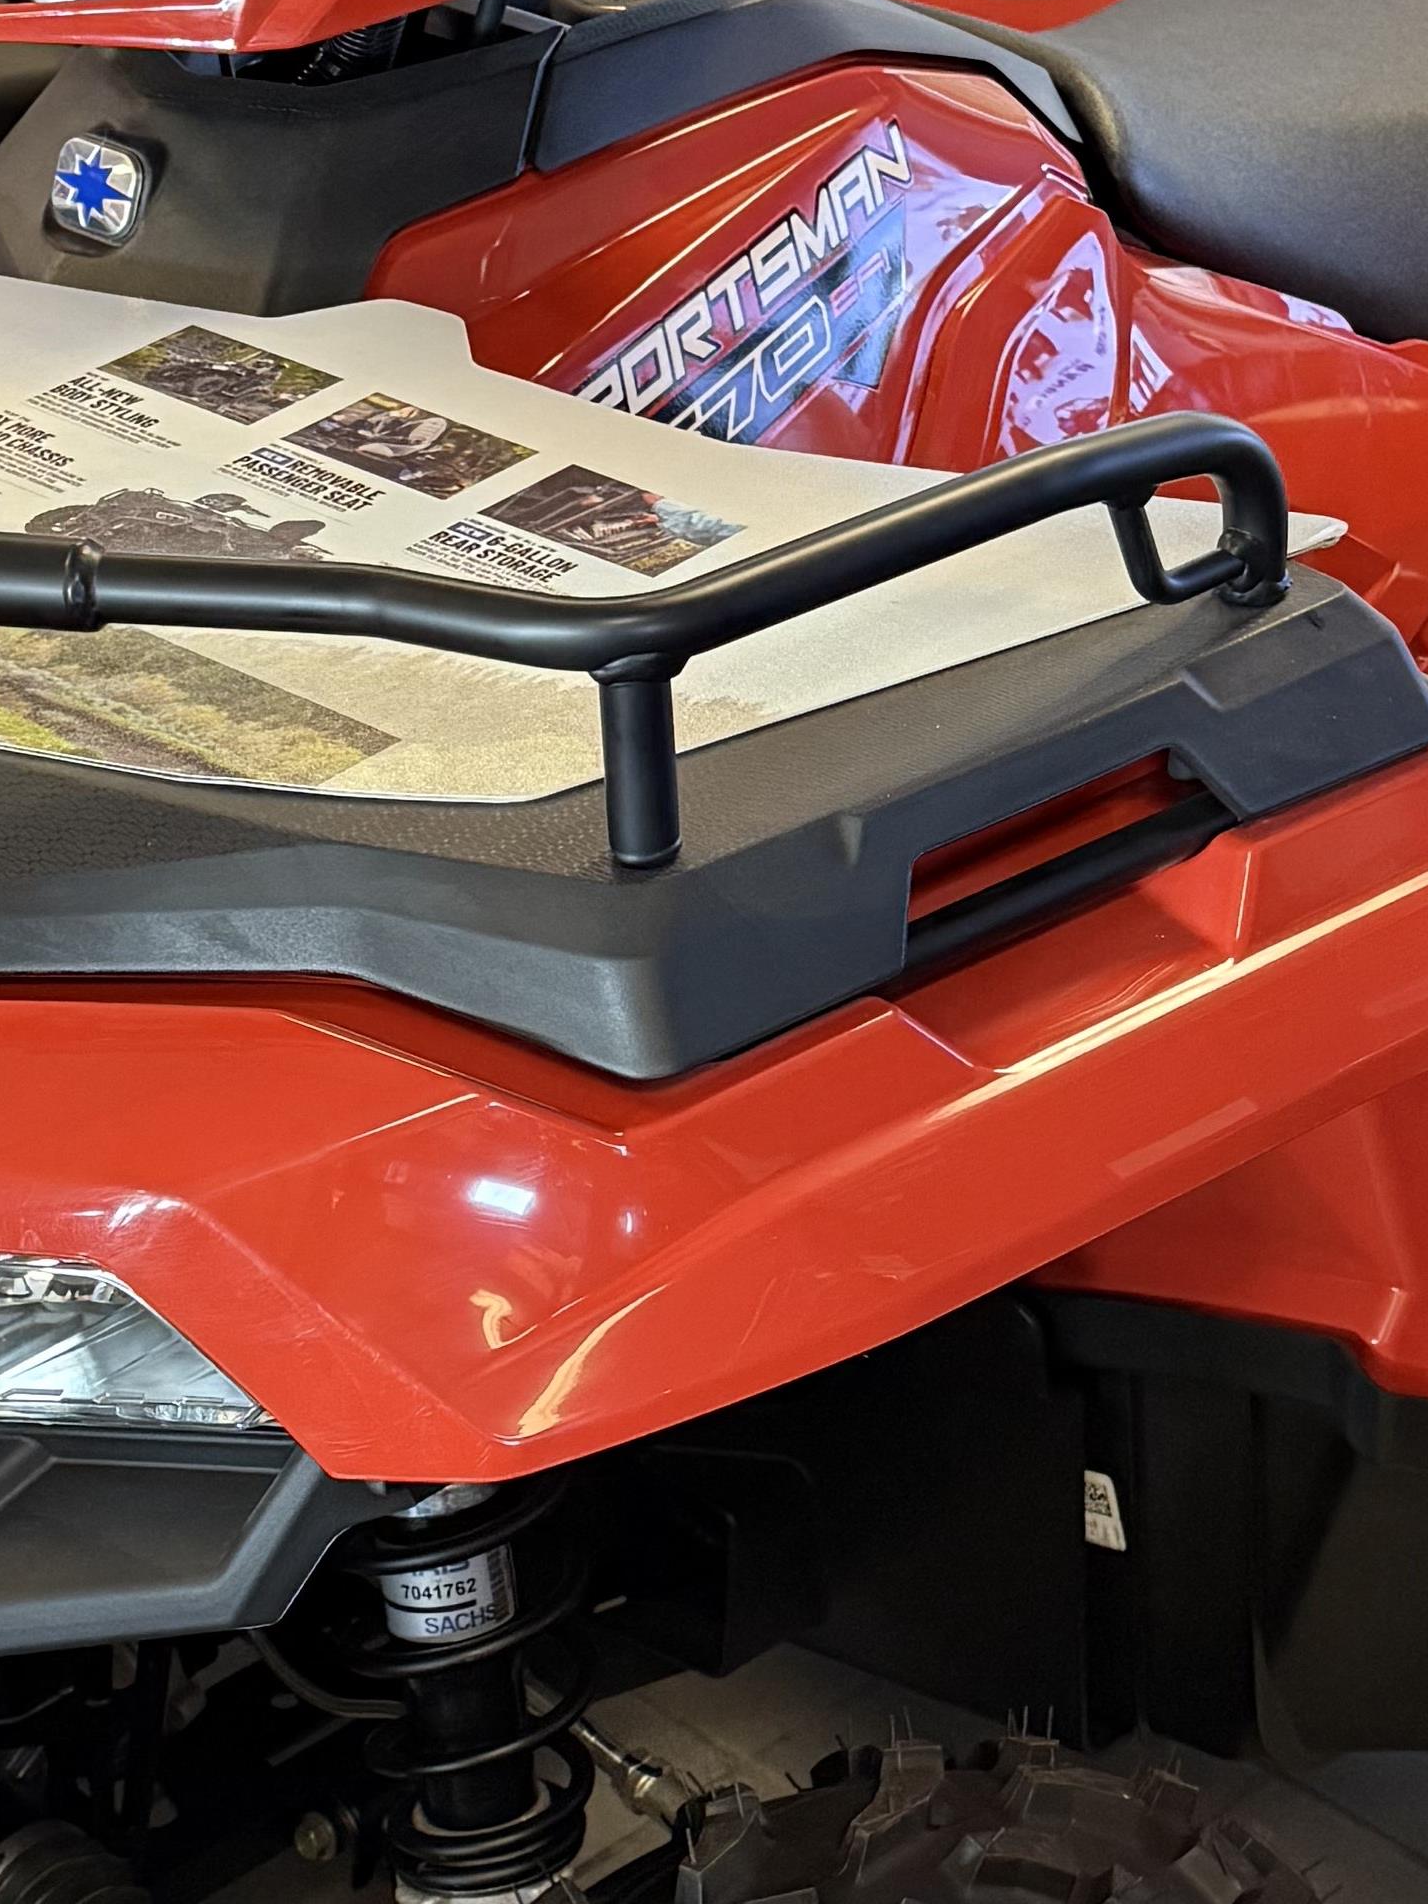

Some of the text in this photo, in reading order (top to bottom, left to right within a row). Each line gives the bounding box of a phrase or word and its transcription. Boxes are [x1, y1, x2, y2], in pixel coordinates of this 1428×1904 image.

[573, 118, 913, 419] PORTSMAN
[49, 384, 160, 429] BODY STYLING
[69, 376, 144, 407] ALL-NEW
[5, 420, 56, 444] MORE
[6, 438, 74, 468] CHASSIS
[232, 456, 328, 495] PASSENGER
[323, 490, 373, 511] SEAT
[285, 459, 386, 500] REMOVABLE
[428, 531, 478, 554] REAR
[475, 548, 561, 583] STORAGE
[486, 536, 579, 573] 6-GALLON
[400, 1577, 477, 1600] 7041762
[424, 1604, 497, 1635] SACHS
